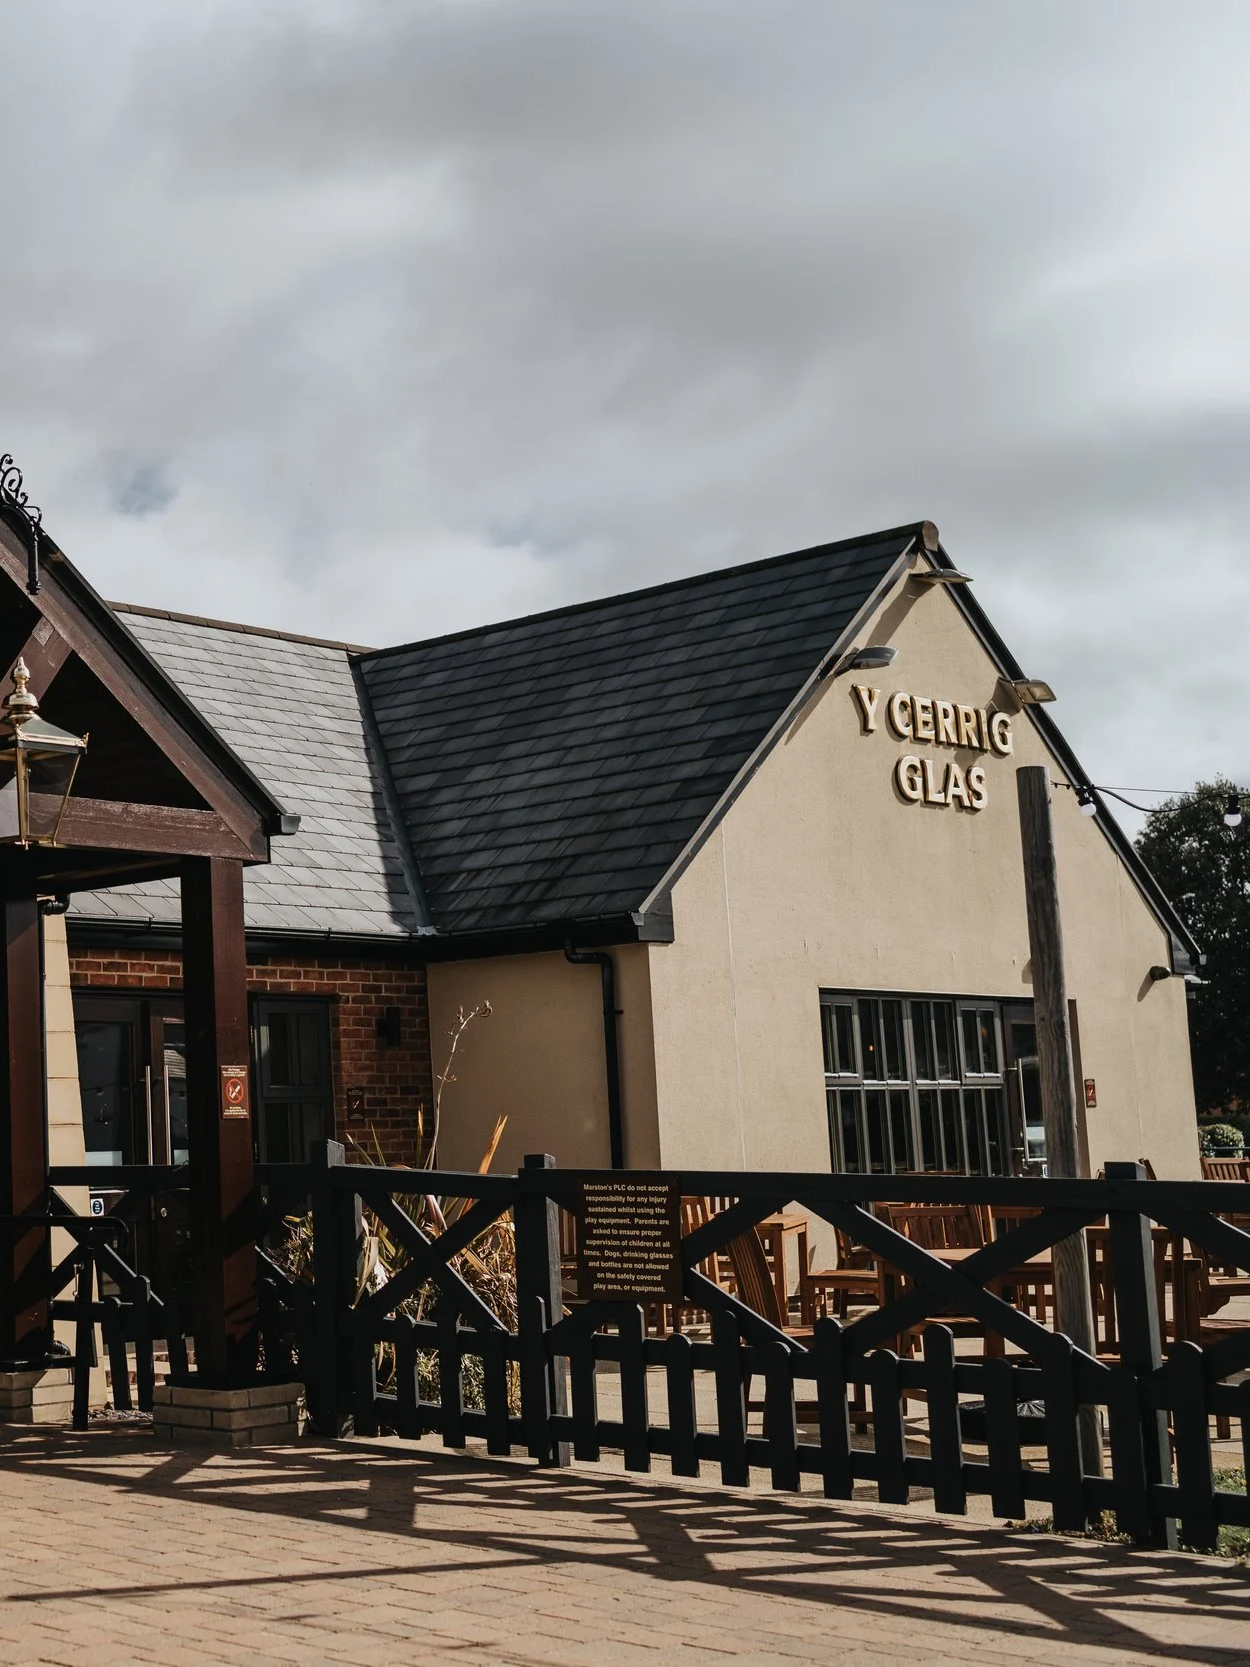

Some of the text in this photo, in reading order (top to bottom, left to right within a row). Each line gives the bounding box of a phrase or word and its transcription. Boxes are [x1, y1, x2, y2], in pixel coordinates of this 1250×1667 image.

[852, 684, 1013, 755] Y CERRIG
[897, 755, 988, 811] GLAS
[585, 1195, 626, 1204] responsibility
[648, 1196, 667, 1204] injury
[636, 1207, 654, 1215] using
[586, 1239, 621, 1247] supervision
[604, 1250, 623, 1258] Dogs,
[622, 1251, 649, 1259] drinking
[649, 1252, 674, 1260] glasses
[617, 1273, 636, 1281] safety
[631, 1285, 666, 1293] equipment.
